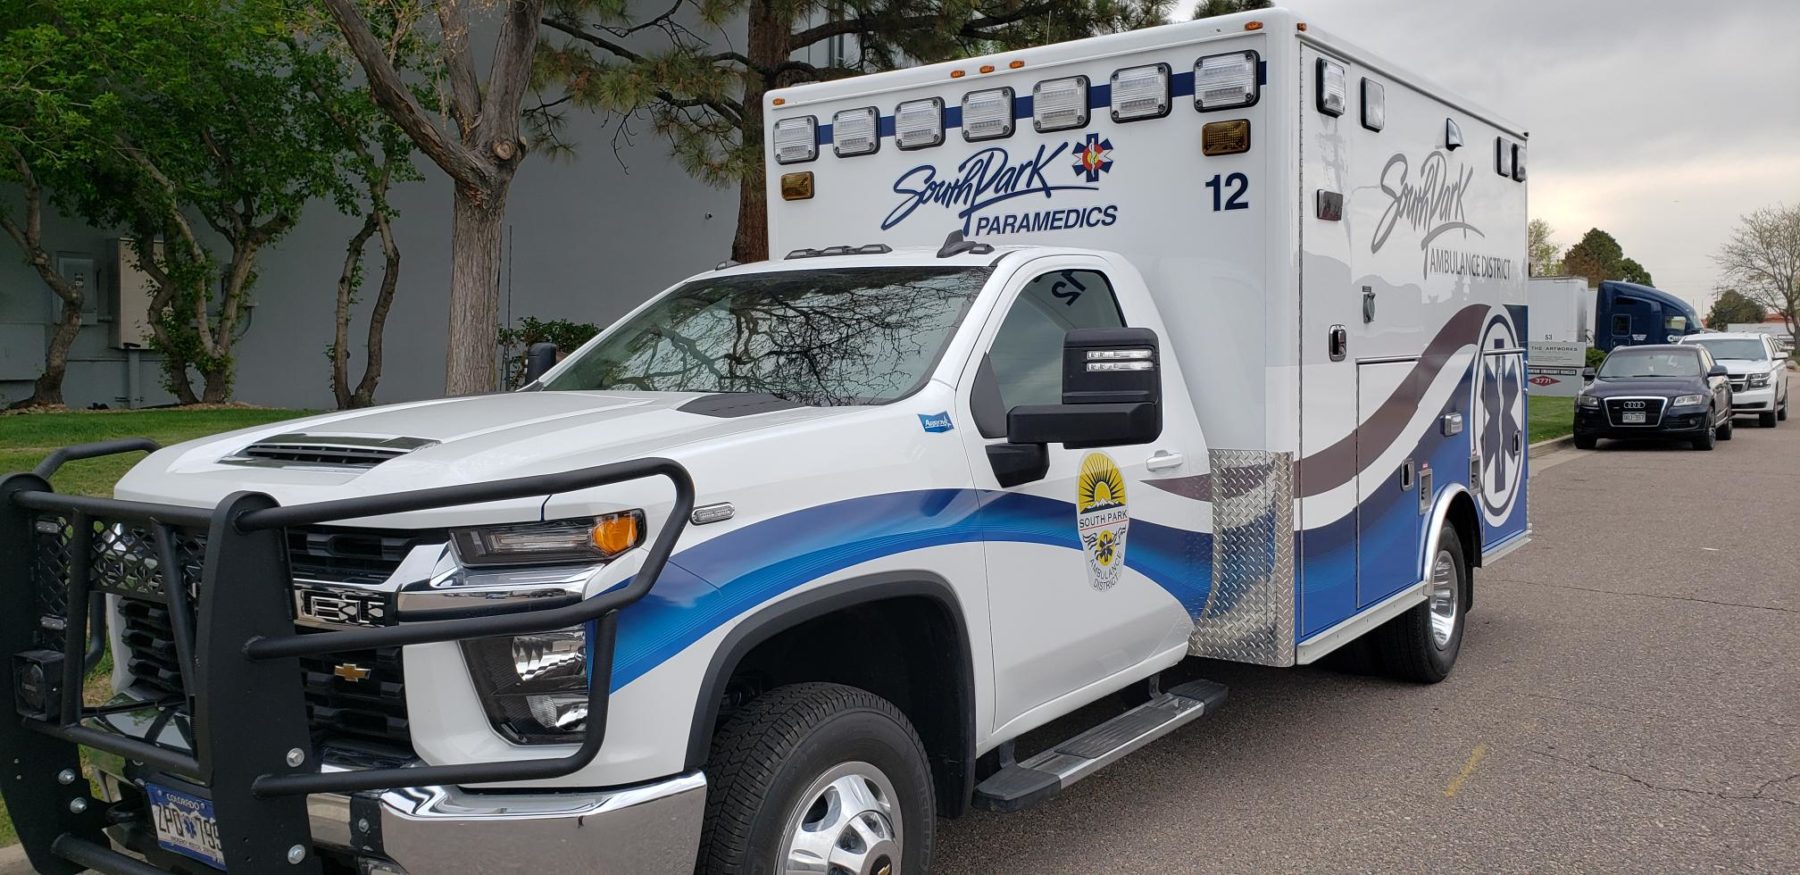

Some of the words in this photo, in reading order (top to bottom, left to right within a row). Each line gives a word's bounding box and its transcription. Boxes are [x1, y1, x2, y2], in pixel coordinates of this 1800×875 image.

[1205, 172, 1250, 212] 12
[975, 205, 1119, 237] PARAMEDICS
[1429, 248, 1481, 277] AMBULANCE
[1481, 256, 1511, 281] DISTRICT
[1079, 513, 1106, 528] SOUTH
[1107, 510, 1128, 521] PARK
[1089, 551, 1122, 580] AMBULANCE
[1093, 573, 1119, 591] DISTRICT
[166, 793, 200, 810] COLORADO
